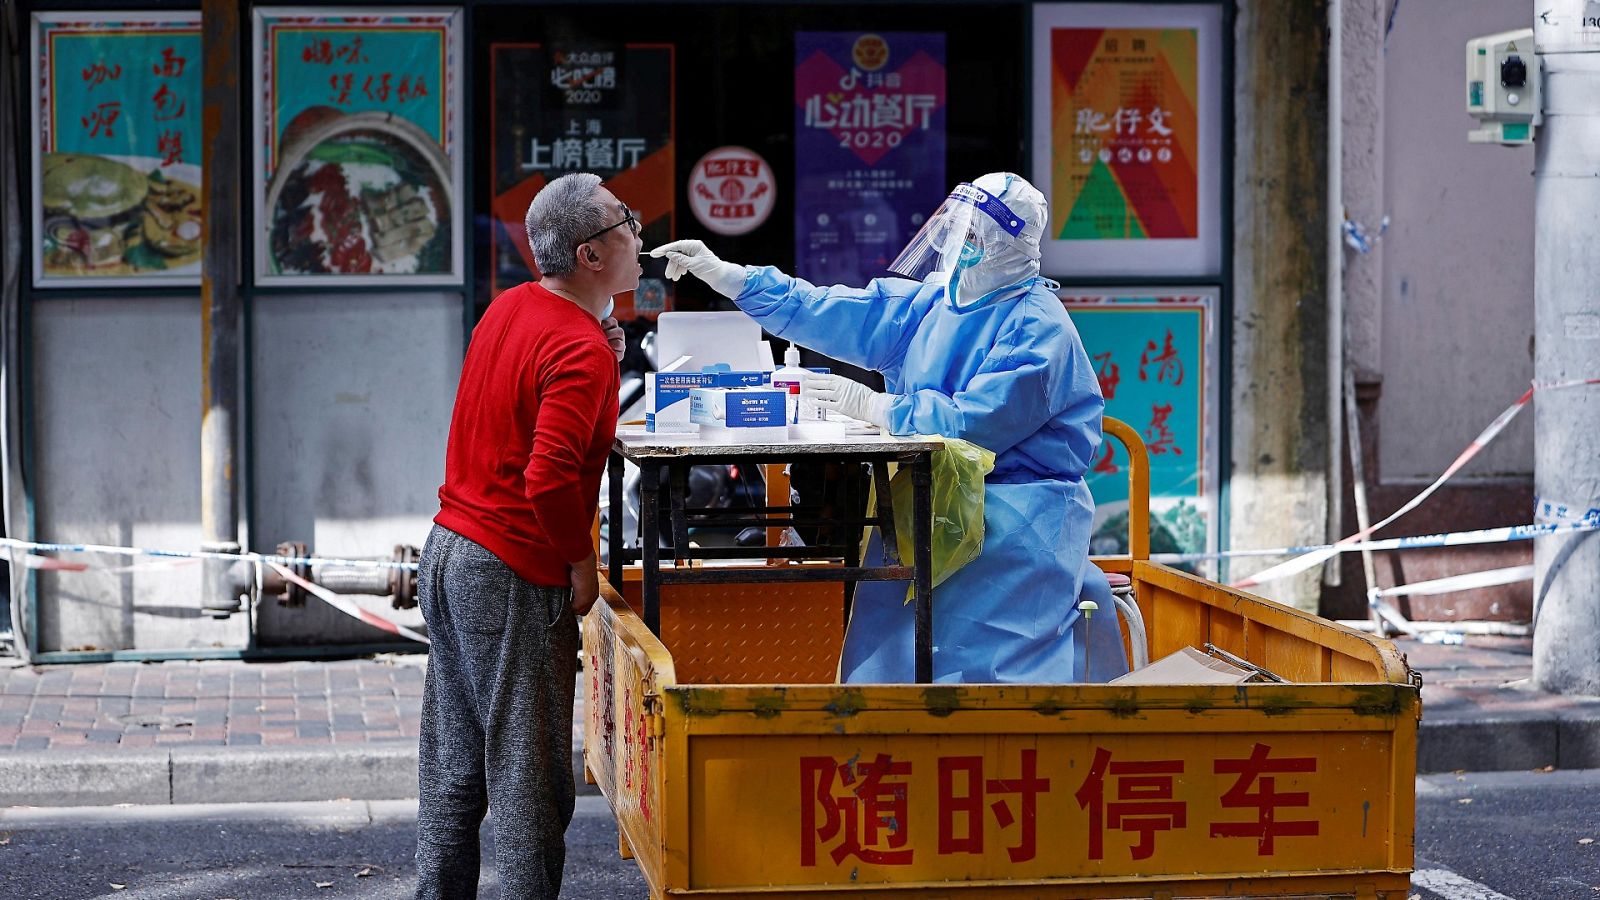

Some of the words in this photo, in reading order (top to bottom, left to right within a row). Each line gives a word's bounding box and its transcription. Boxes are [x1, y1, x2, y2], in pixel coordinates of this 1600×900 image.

[550, 66, 617, 89] 必吃榜
[867, 72, 902, 88] 抖音
[566, 91, 602, 104] 2020
[805, 93, 936, 130] 心动餐厅
[1075, 106, 1173, 136] 肥仔文
[564, 118, 602, 135] 上海
[839, 131, 902, 148] 2020
[521, 137, 646, 169] 上榜餐厅
[1139, 329, 1185, 456] 清蒸
[799, 742, 1319, 867] 随时停车
